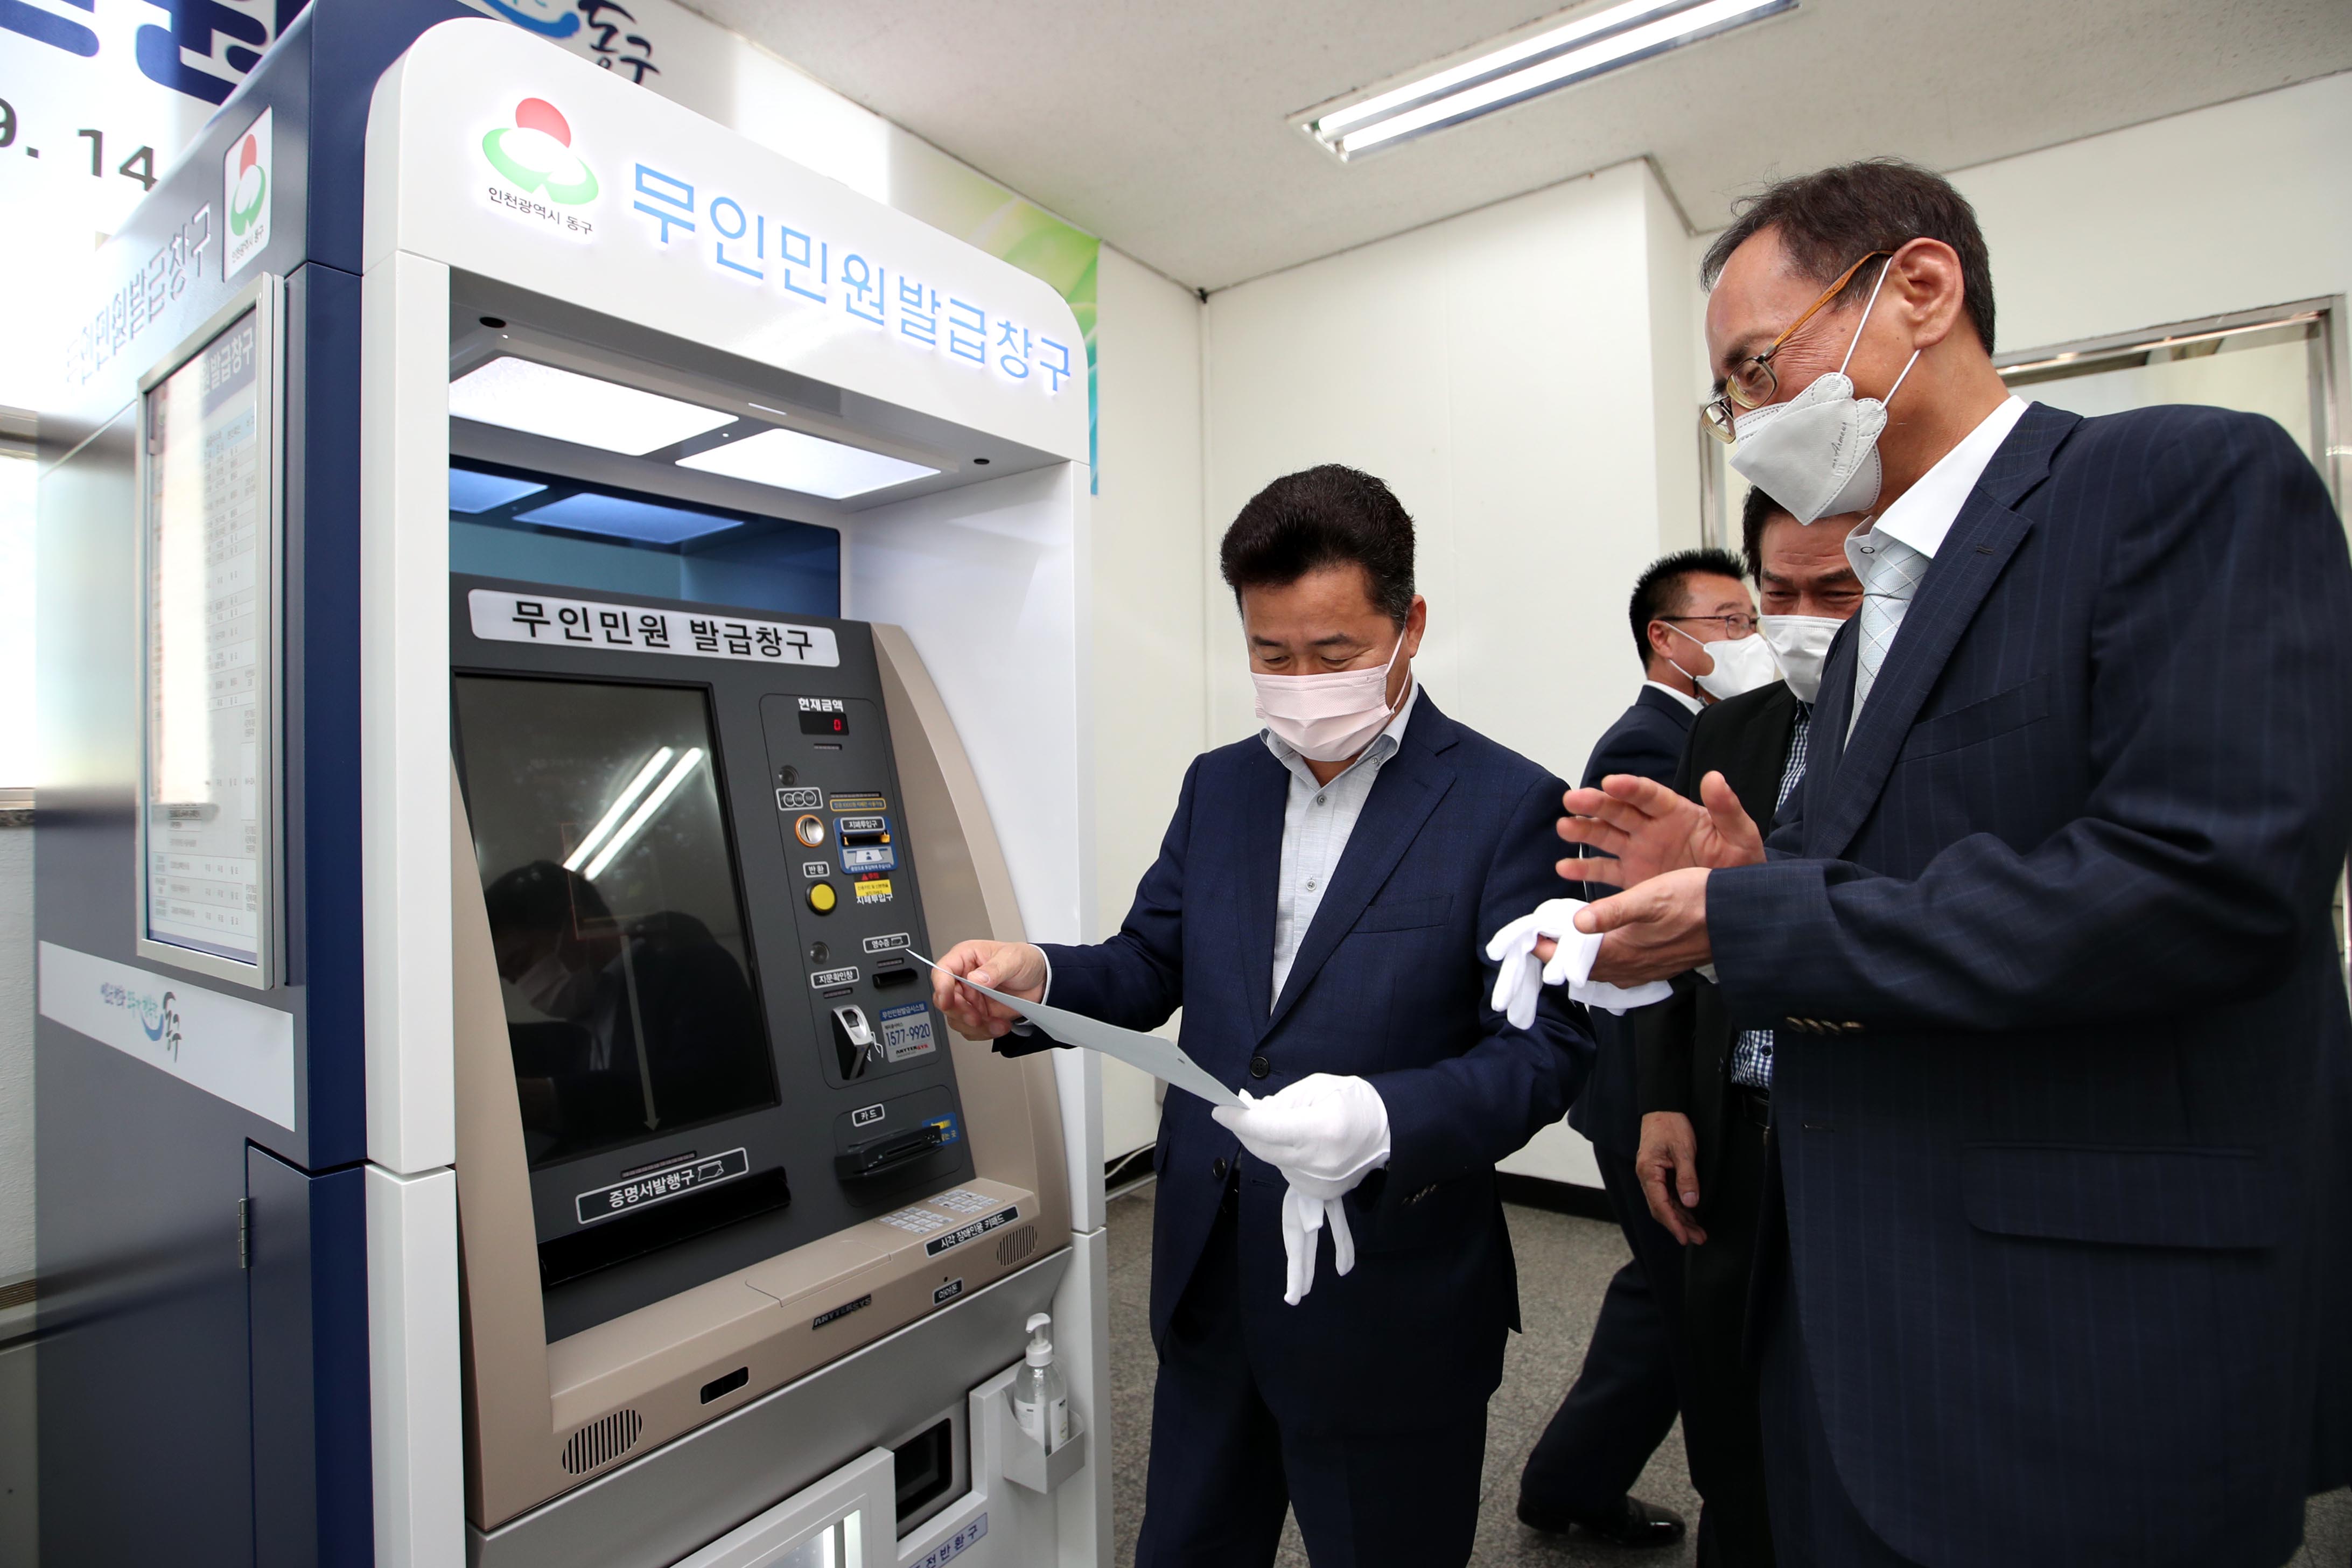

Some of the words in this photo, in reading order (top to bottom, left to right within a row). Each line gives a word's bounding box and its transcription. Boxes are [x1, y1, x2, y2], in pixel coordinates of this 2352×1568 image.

[488, 186, 561, 227] 인천광역시
[565, 215, 594, 236] 동구
[634, 162, 1071, 393] 무인민원발급창구
[512, 599, 671, 648] 무인민원
[690, 619, 814, 661] 발급창구
[798, 697, 844, 712] 현재금액
[885, 1023, 931, 1046] 1577-9920
[609, 1170, 695, 1208] 증명서발행구
[941, 1234, 956, 1248] 시각
[915, 1524, 978, 1568] 전반환구
